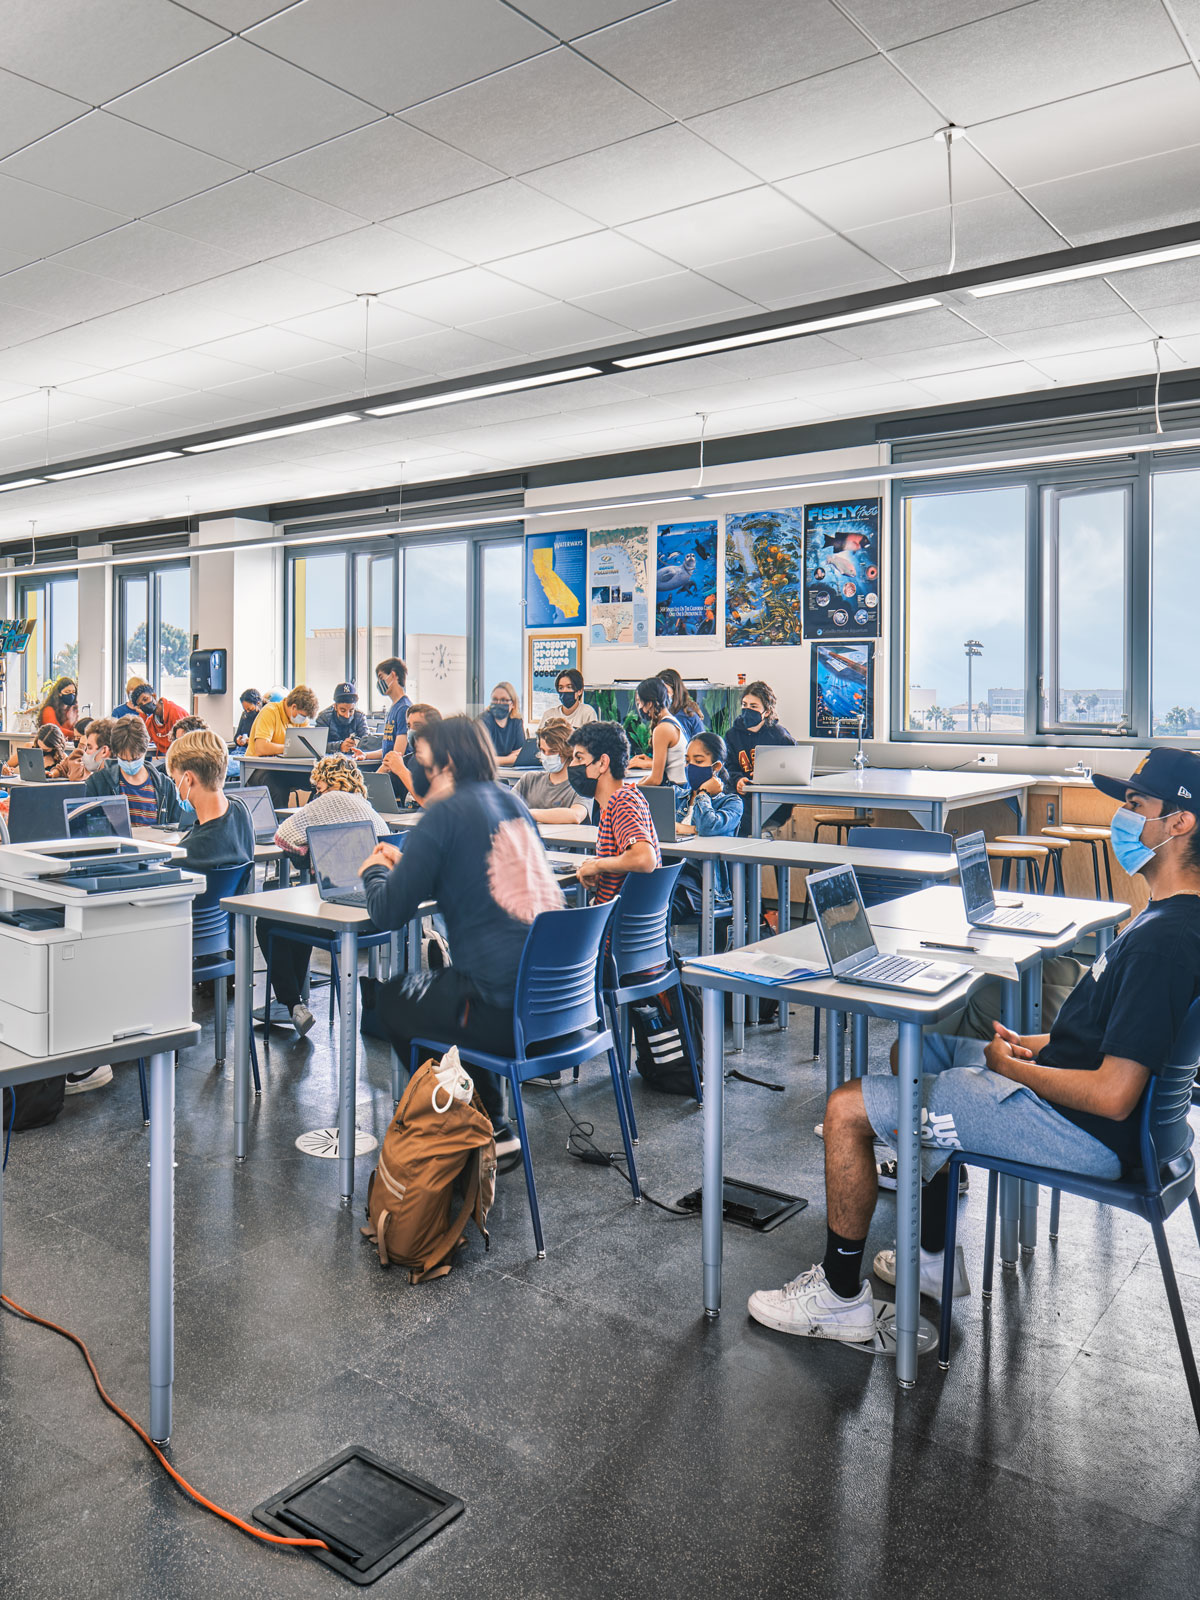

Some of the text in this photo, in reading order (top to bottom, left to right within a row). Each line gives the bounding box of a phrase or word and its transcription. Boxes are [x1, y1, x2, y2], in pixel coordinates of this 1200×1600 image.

[807, 505, 860, 521] FISHY
[554, 540, 583, 550] WATERWAYS
[533, 640, 576, 649] preserve
[533, 649, 569, 657] protect
[533, 657, 570, 665] restore
